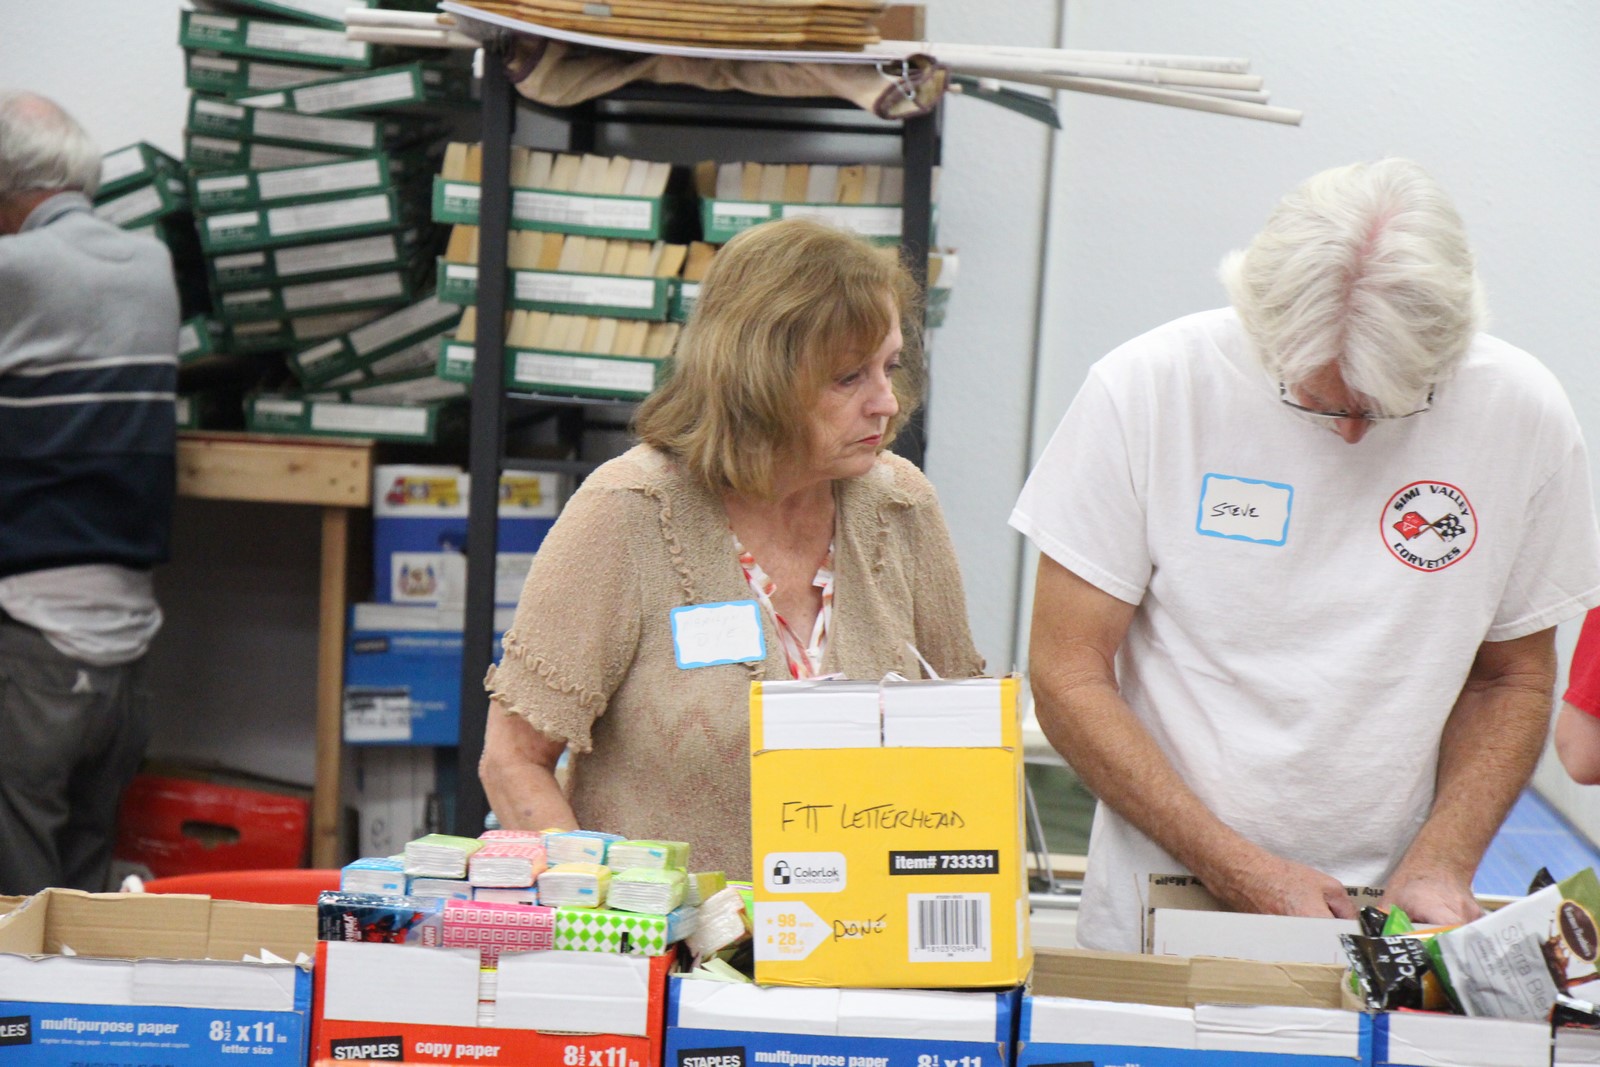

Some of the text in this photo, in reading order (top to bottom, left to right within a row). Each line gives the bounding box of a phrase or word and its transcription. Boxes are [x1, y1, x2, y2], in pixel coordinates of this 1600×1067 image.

[1393, 484, 1470, 516] SIMI VALLEY
[1210, 501, 1260, 518] STEVE
[1393, 541, 1462, 569] CORVETTES
[840, 802, 966, 830] LETTERHEAD
[940, 854, 994, 869] 733331
[793, 867, 839, 878] ColorLok
[777, 913, 796, 927] 98
[777, 932, 797, 945] 28
[1501, 925, 1532, 976] Sierra
[40, 1017, 135, 1034] multipurpose
[137, 1022, 179, 1036] paper
[276, 1034, 288, 1043] in
[221, 1044, 274, 1055] letter size
[334, 1043, 400, 1060] STAPLES
[415, 1041, 453, 1058] copy
[455, 1043, 501, 1060] paper
[683, 1055, 741, 1067] STAPLES
[755, 1050, 845, 1067] multipurpose
[849, 1056, 890, 1067] paper
